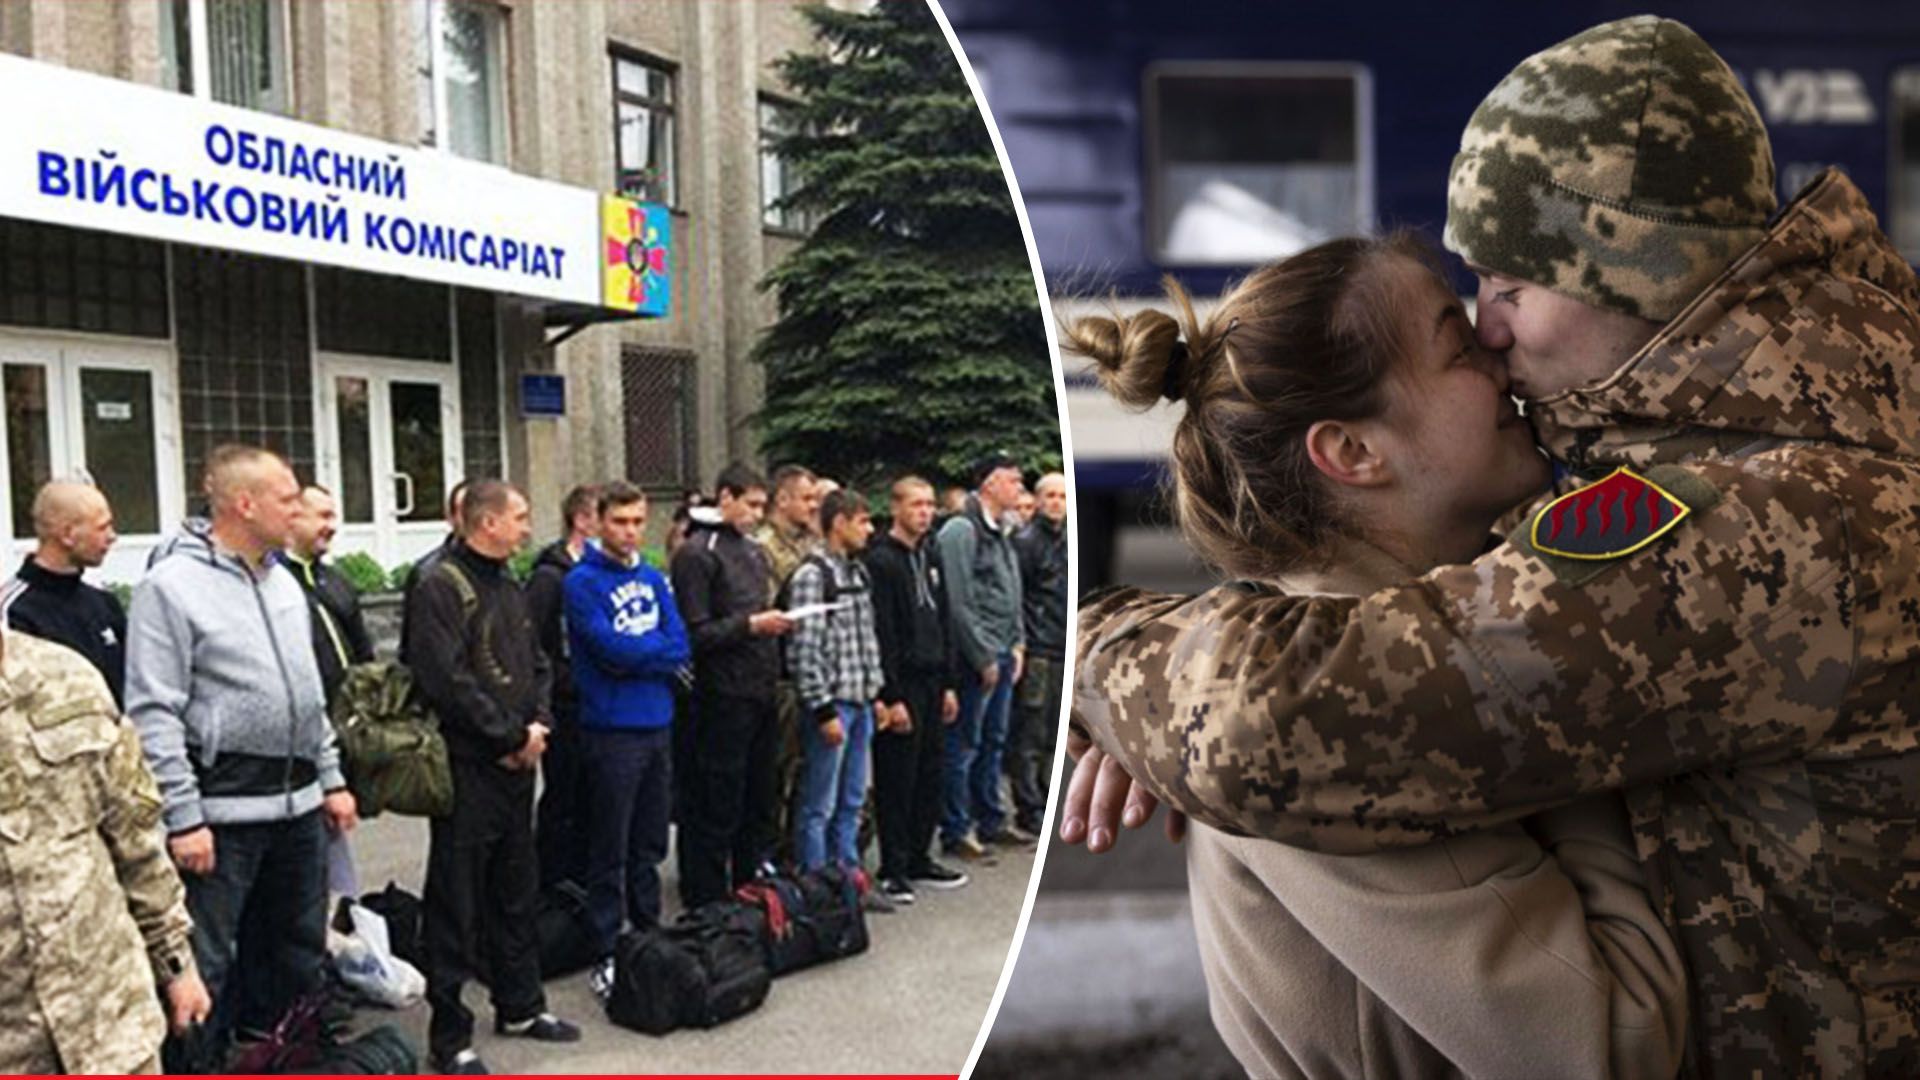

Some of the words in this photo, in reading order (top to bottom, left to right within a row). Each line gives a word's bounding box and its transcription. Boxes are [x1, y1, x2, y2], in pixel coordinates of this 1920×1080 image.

[204, 124, 406, 200] ОБЛАСНИЙ
[37, 150, 349, 243] ВІЙСЬКОВИЙ
[364, 213, 566, 281] КОМІСАРІАТ
